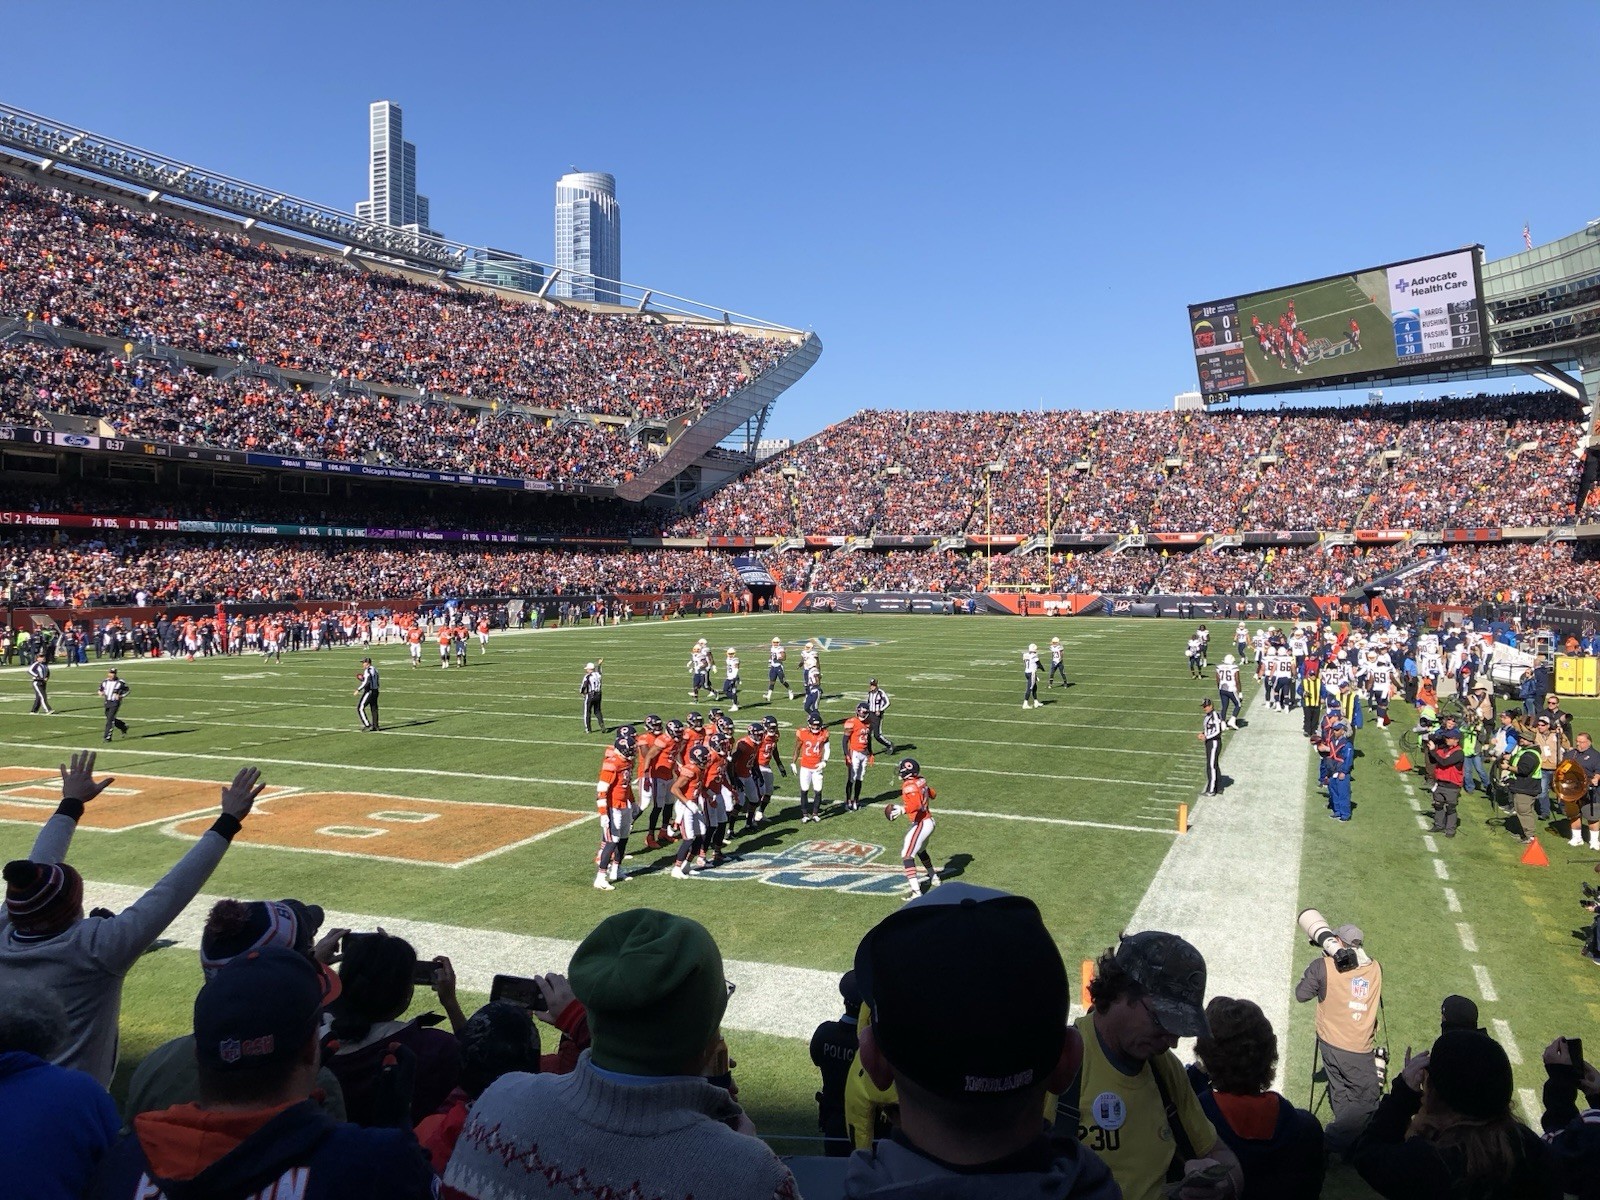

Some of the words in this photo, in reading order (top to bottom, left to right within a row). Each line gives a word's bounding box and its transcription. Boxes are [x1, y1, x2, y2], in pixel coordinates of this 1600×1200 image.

[1411, 270, 1458, 287] Advocate
[1411, 284, 1443, 297] Health
[1444, 280, 1468, 291] Care
[1203, 306, 1216, 317] Lite
[1424, 307, 1443, 316] YARDS
[1222, 315, 1231, 329] 0
[1404, 322, 1410, 331] 4
[1422, 317, 1448, 328] RUSHING
[1458, 313, 1469, 323] 15
[1458, 324, 1470, 334] 62
[1224, 329, 1233, 343] 0
[1404, 333, 1414, 343] 16
[1423, 329, 1449, 340] PASSING
[1461, 336, 1471, 346] 77
[1405, 345, 1415, 355] 20
[1428, 341, 1446, 350] TOTAL
[32, 430, 41, 444] 0
[106, 439, 125, 451] 0:37
[144, 443, 156, 455] 1st
[361, 466, 389, 477] Chicago's
[389, 469, 411, 478] Weather
[412, 471, 431, 480] Station
[15, 514, 23, 524] 2.
[26, 515, 59, 526] Peterson
[92, 517, 101, 527] 76
[104, 518, 120, 529] YDS,
[138, 520, 150, 530] TD,
[154, 521, 164, 530] 29
[164, 521, 178, 531] LNG
[250, 526, 278, 534] Fournette
[299, 527, 307, 535] 66
[308, 527, 320, 537] YDS,
[346, 528, 354, 537] 66
[354, 529, 365, 537] LNG
[422, 532, 444, 540] Mattison
[1280, 662, 1292, 672] 66
[1427, 659, 1437, 669] 13
[1219, 669, 1232, 681] 76
[1326, 673, 1339, 685] 25
[1373, 672, 1386, 684] 69
[804, 740, 821, 756] 24
[823, 1042, 854, 1062] POLIC
